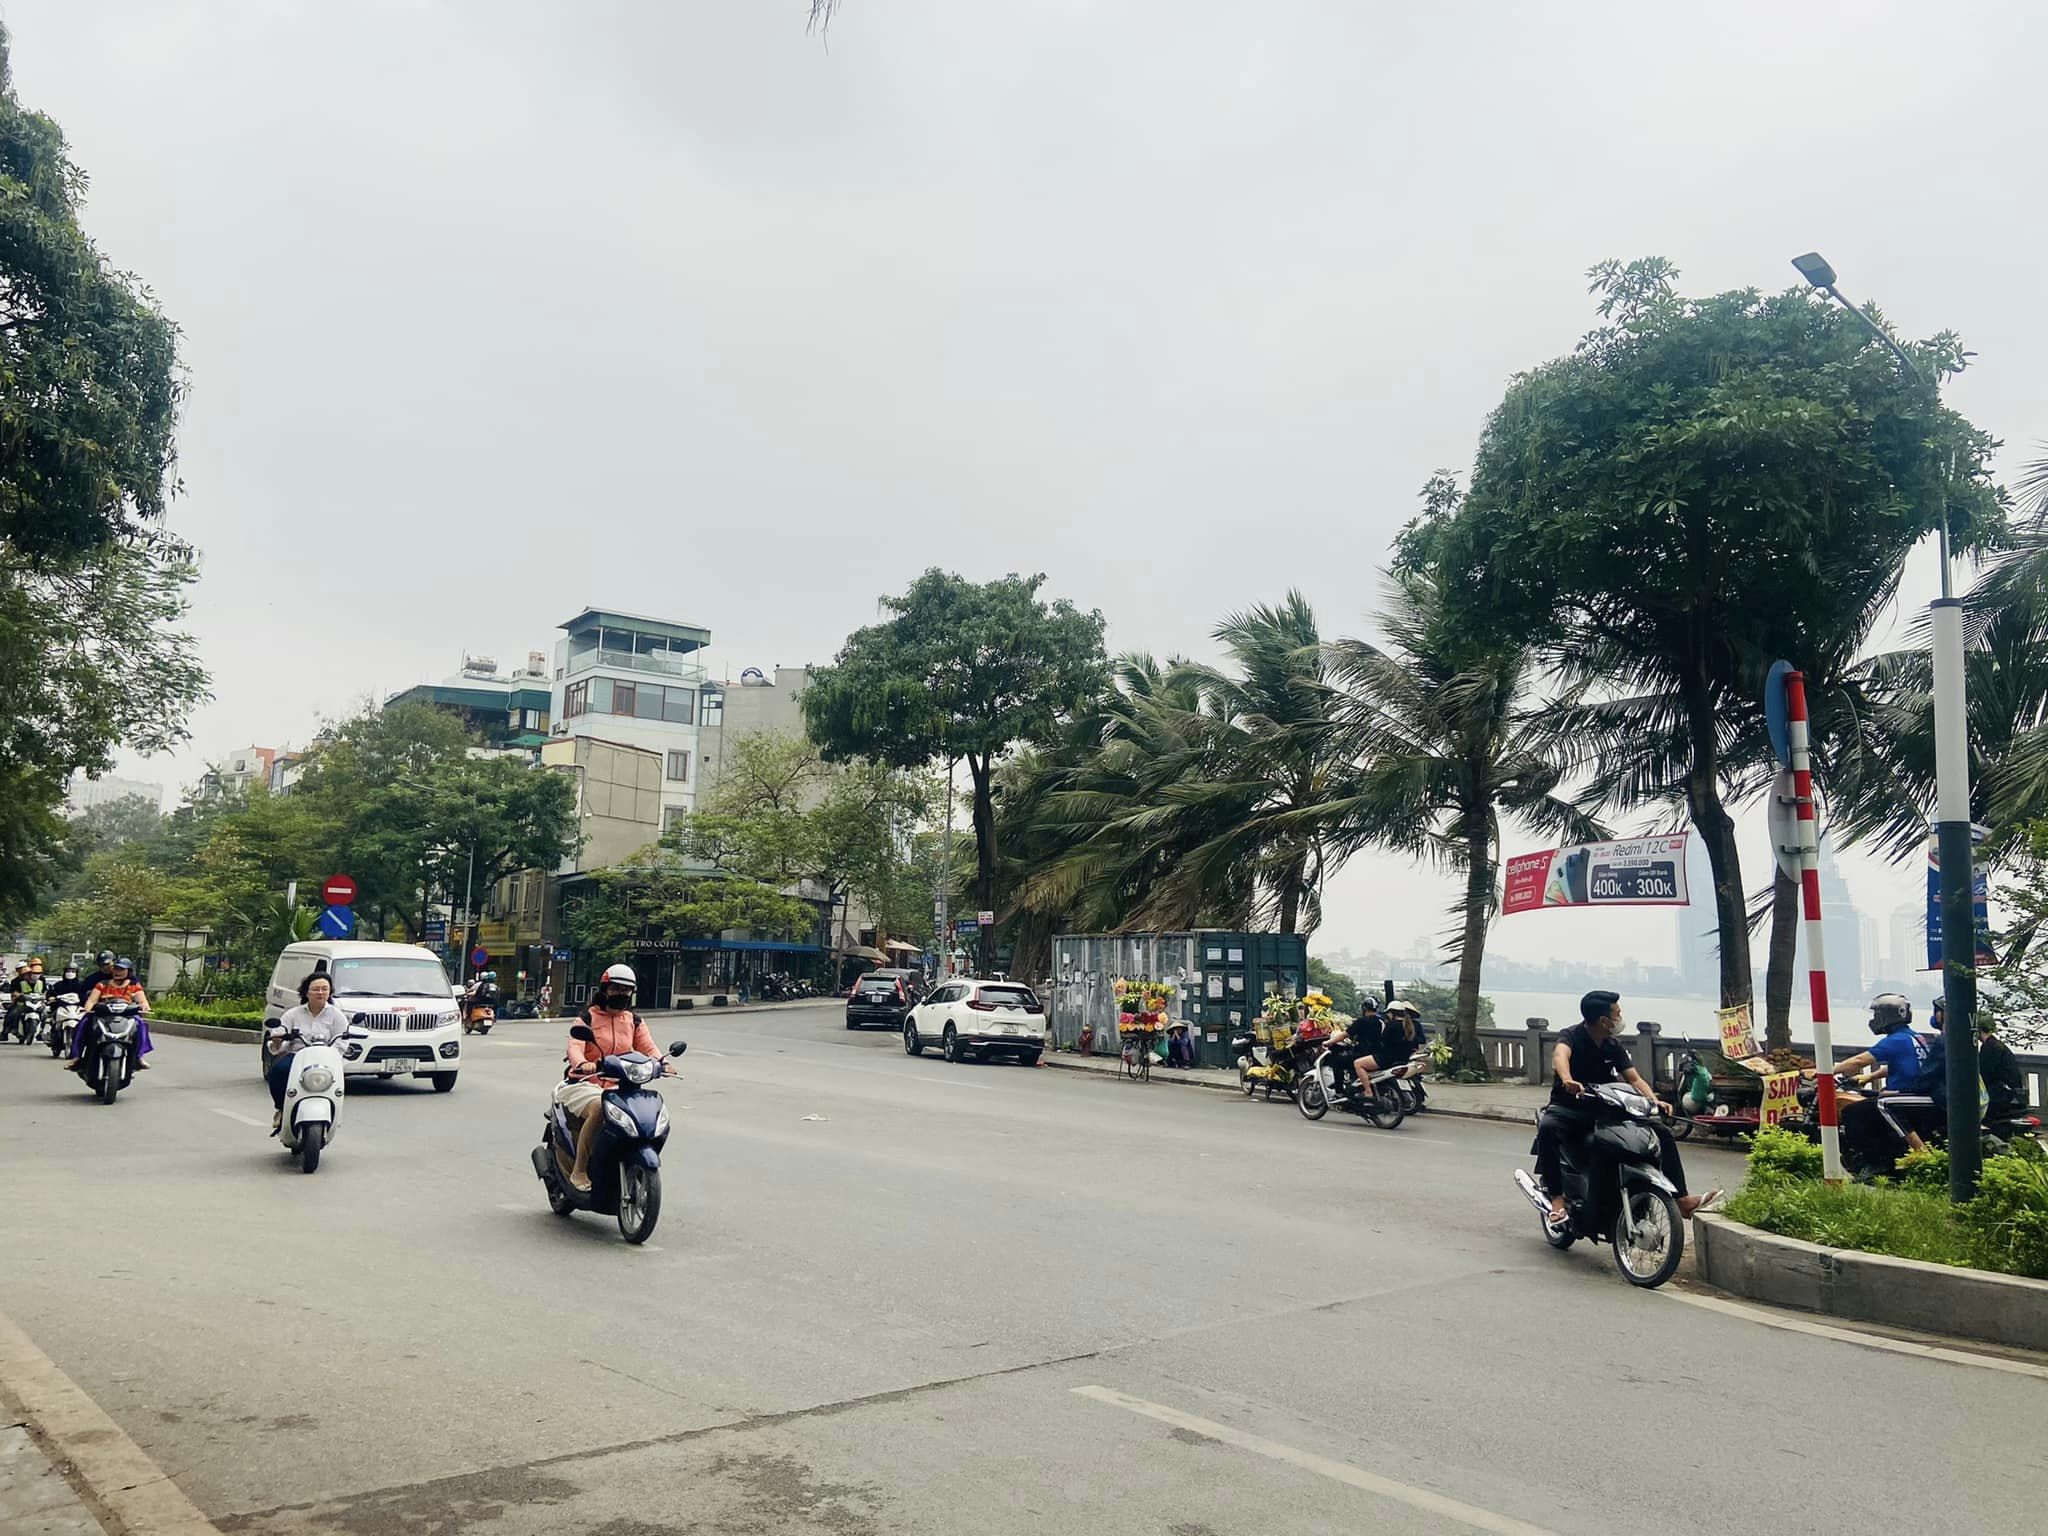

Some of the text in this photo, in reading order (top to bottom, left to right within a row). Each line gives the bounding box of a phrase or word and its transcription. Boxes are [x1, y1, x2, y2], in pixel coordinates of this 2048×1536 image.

[1613, 841, 1644, 857] Redmi
[1646, 840, 1668, 854] 12C
[1636, 878, 1673, 896] 300K
